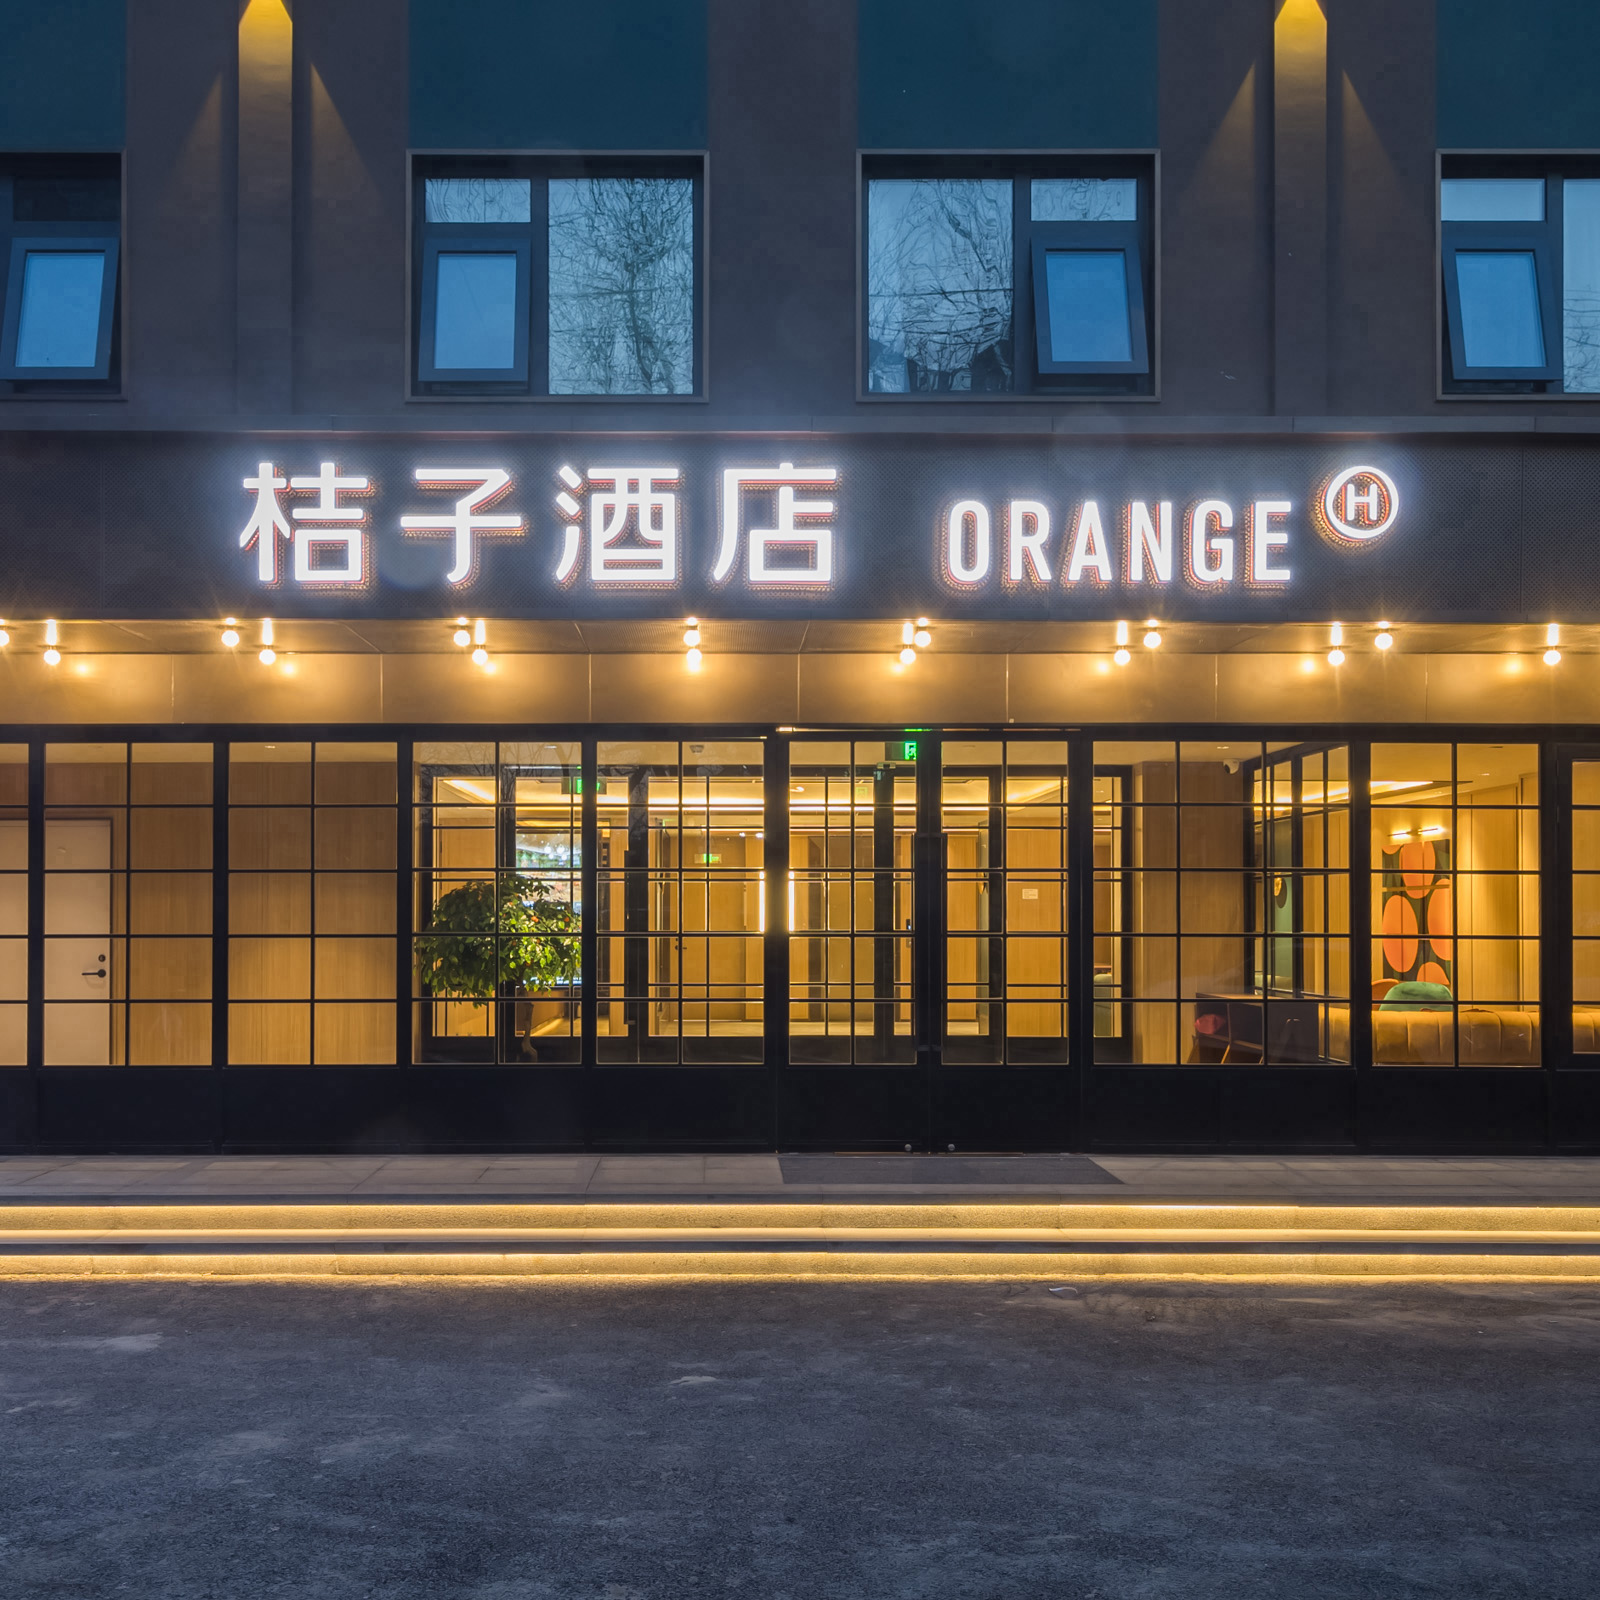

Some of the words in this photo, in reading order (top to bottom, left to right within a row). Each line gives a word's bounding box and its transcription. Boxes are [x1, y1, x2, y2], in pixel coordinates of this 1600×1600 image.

[238, 460, 842, 586] 桔子酒店
[944, 499, 1293, 584] ORANGE
